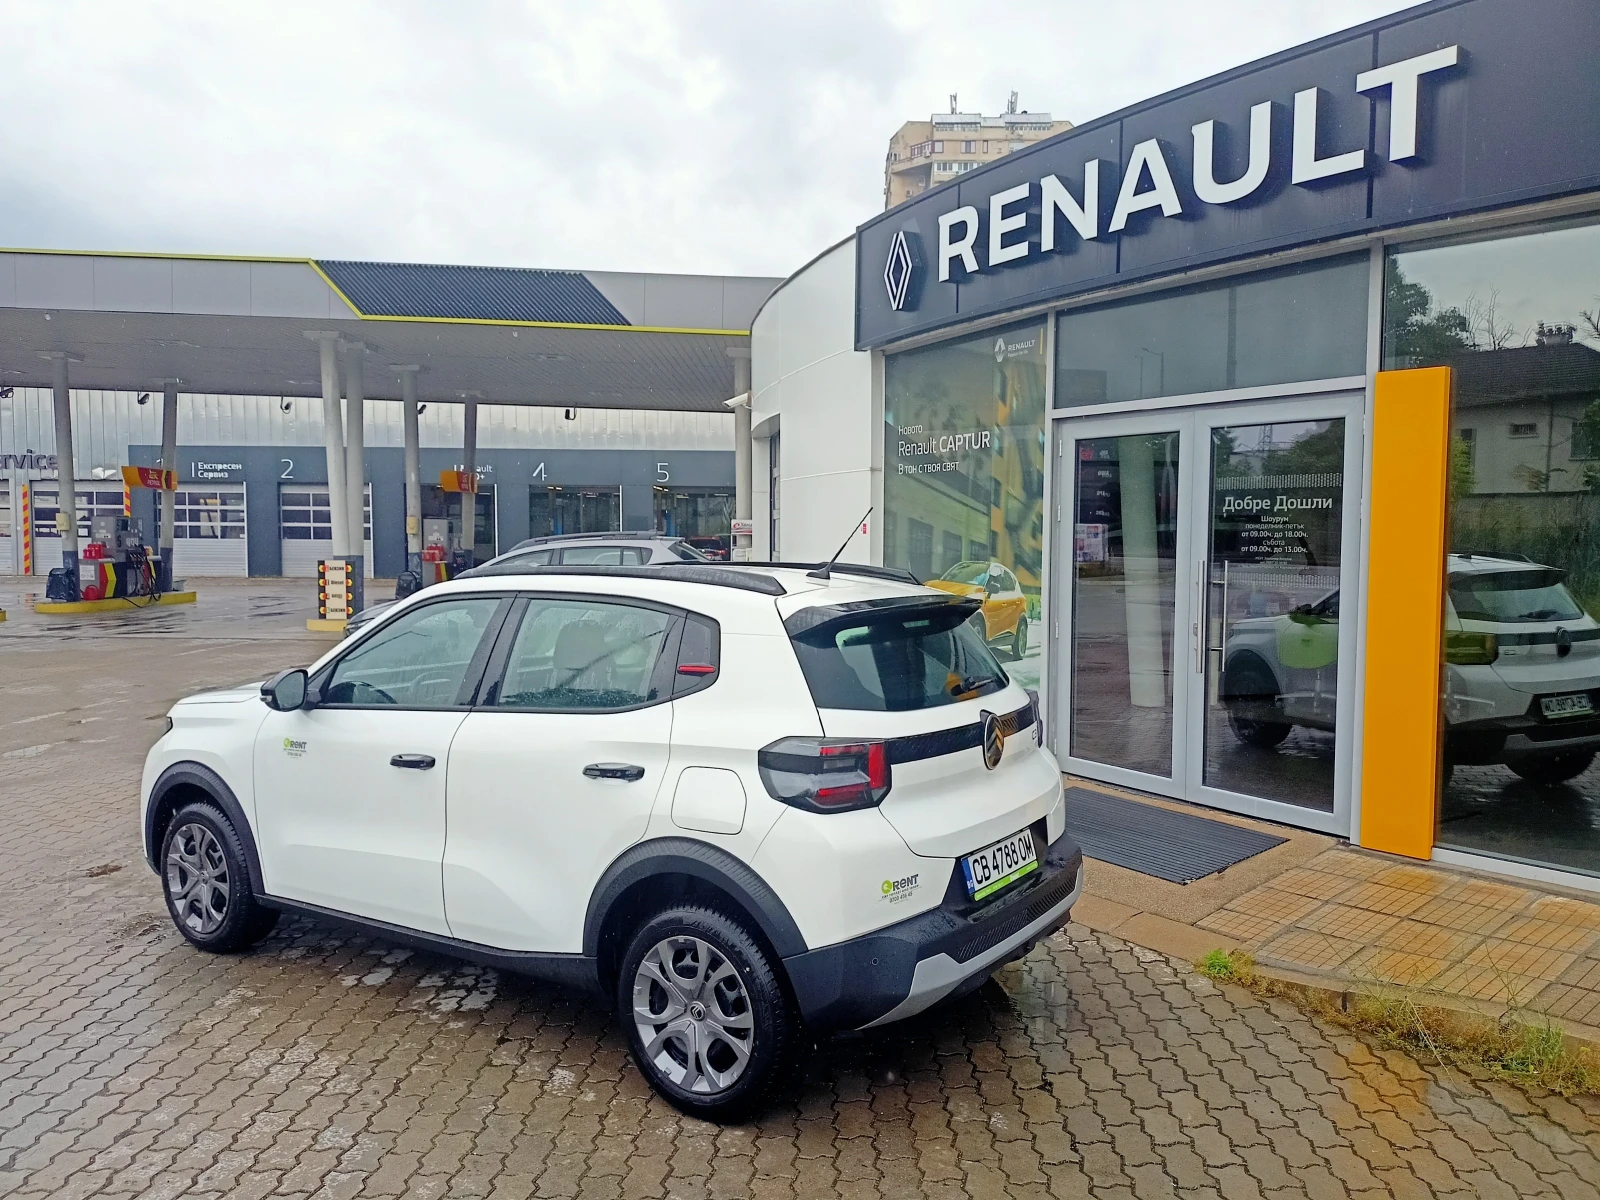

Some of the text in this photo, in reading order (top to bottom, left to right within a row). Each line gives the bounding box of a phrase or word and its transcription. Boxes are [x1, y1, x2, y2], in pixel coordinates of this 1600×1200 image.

[938, 44, 1458, 283] RENAULT
[1007, 340, 1036, 351] RENAULT
[898, 425, 923, 436] Новото
[898, 431, 991, 457] Renault CAPTUR
[197, 462, 242, 472] Експресен
[197, 470, 229, 480] Сервиз
[280, 459, 294, 479] 2
[532, 462, 548, 481] 4
[656, 462, 670, 482] 5
[1222, 495, 1333, 513] Добре Дошли
[1262, 538, 1285, 546] събота
[972, 854, 991, 885] CB
[992, 841, 1019, 875] 4788
[1017, 833, 1034, 861] OM
